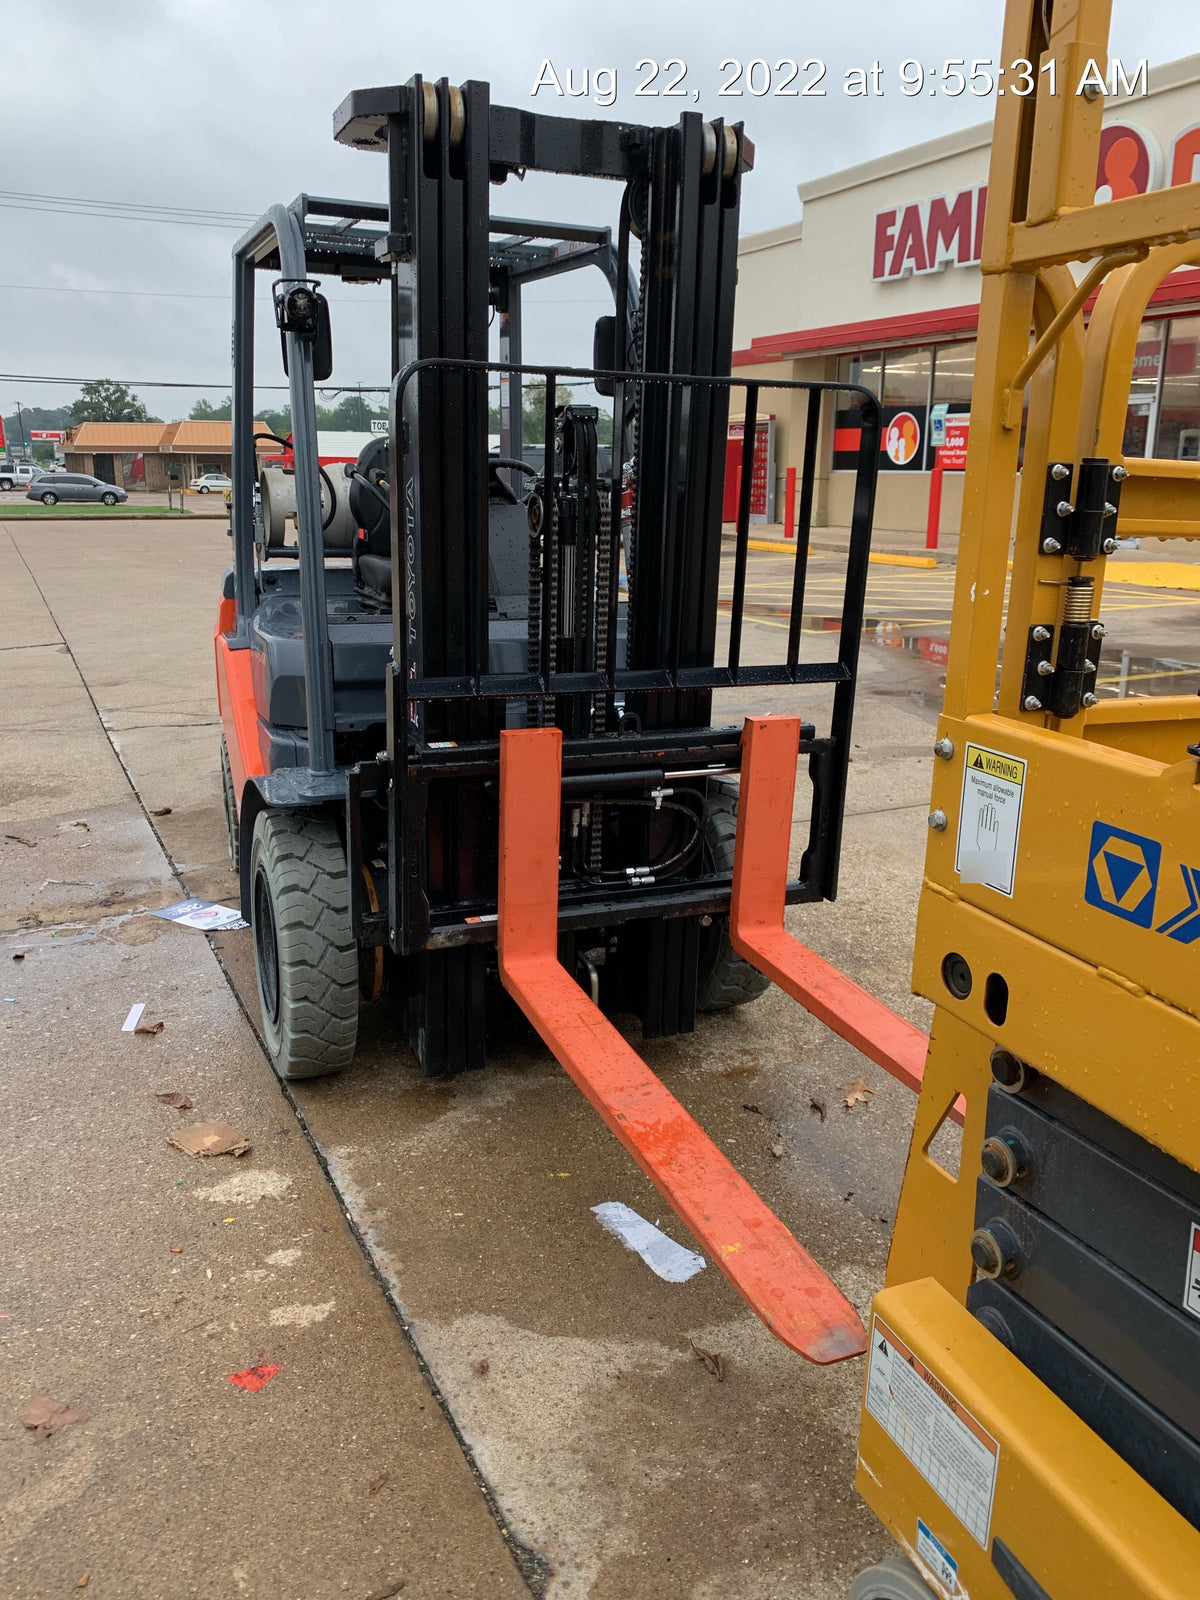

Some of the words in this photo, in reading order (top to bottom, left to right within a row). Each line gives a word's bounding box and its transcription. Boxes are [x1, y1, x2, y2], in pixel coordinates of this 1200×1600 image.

[872, 186, 988, 280] FAMI
[406, 476, 417, 645] TOYOTA
[985, 756, 1018, 779] WARNING
[971, 775, 992, 790] Maximum
[992, 784, 1015, 798] allowable
[976, 788, 993, 800] manual
[994, 792, 1006, 805] force
[923, 1370, 957, 1413] WARNING
